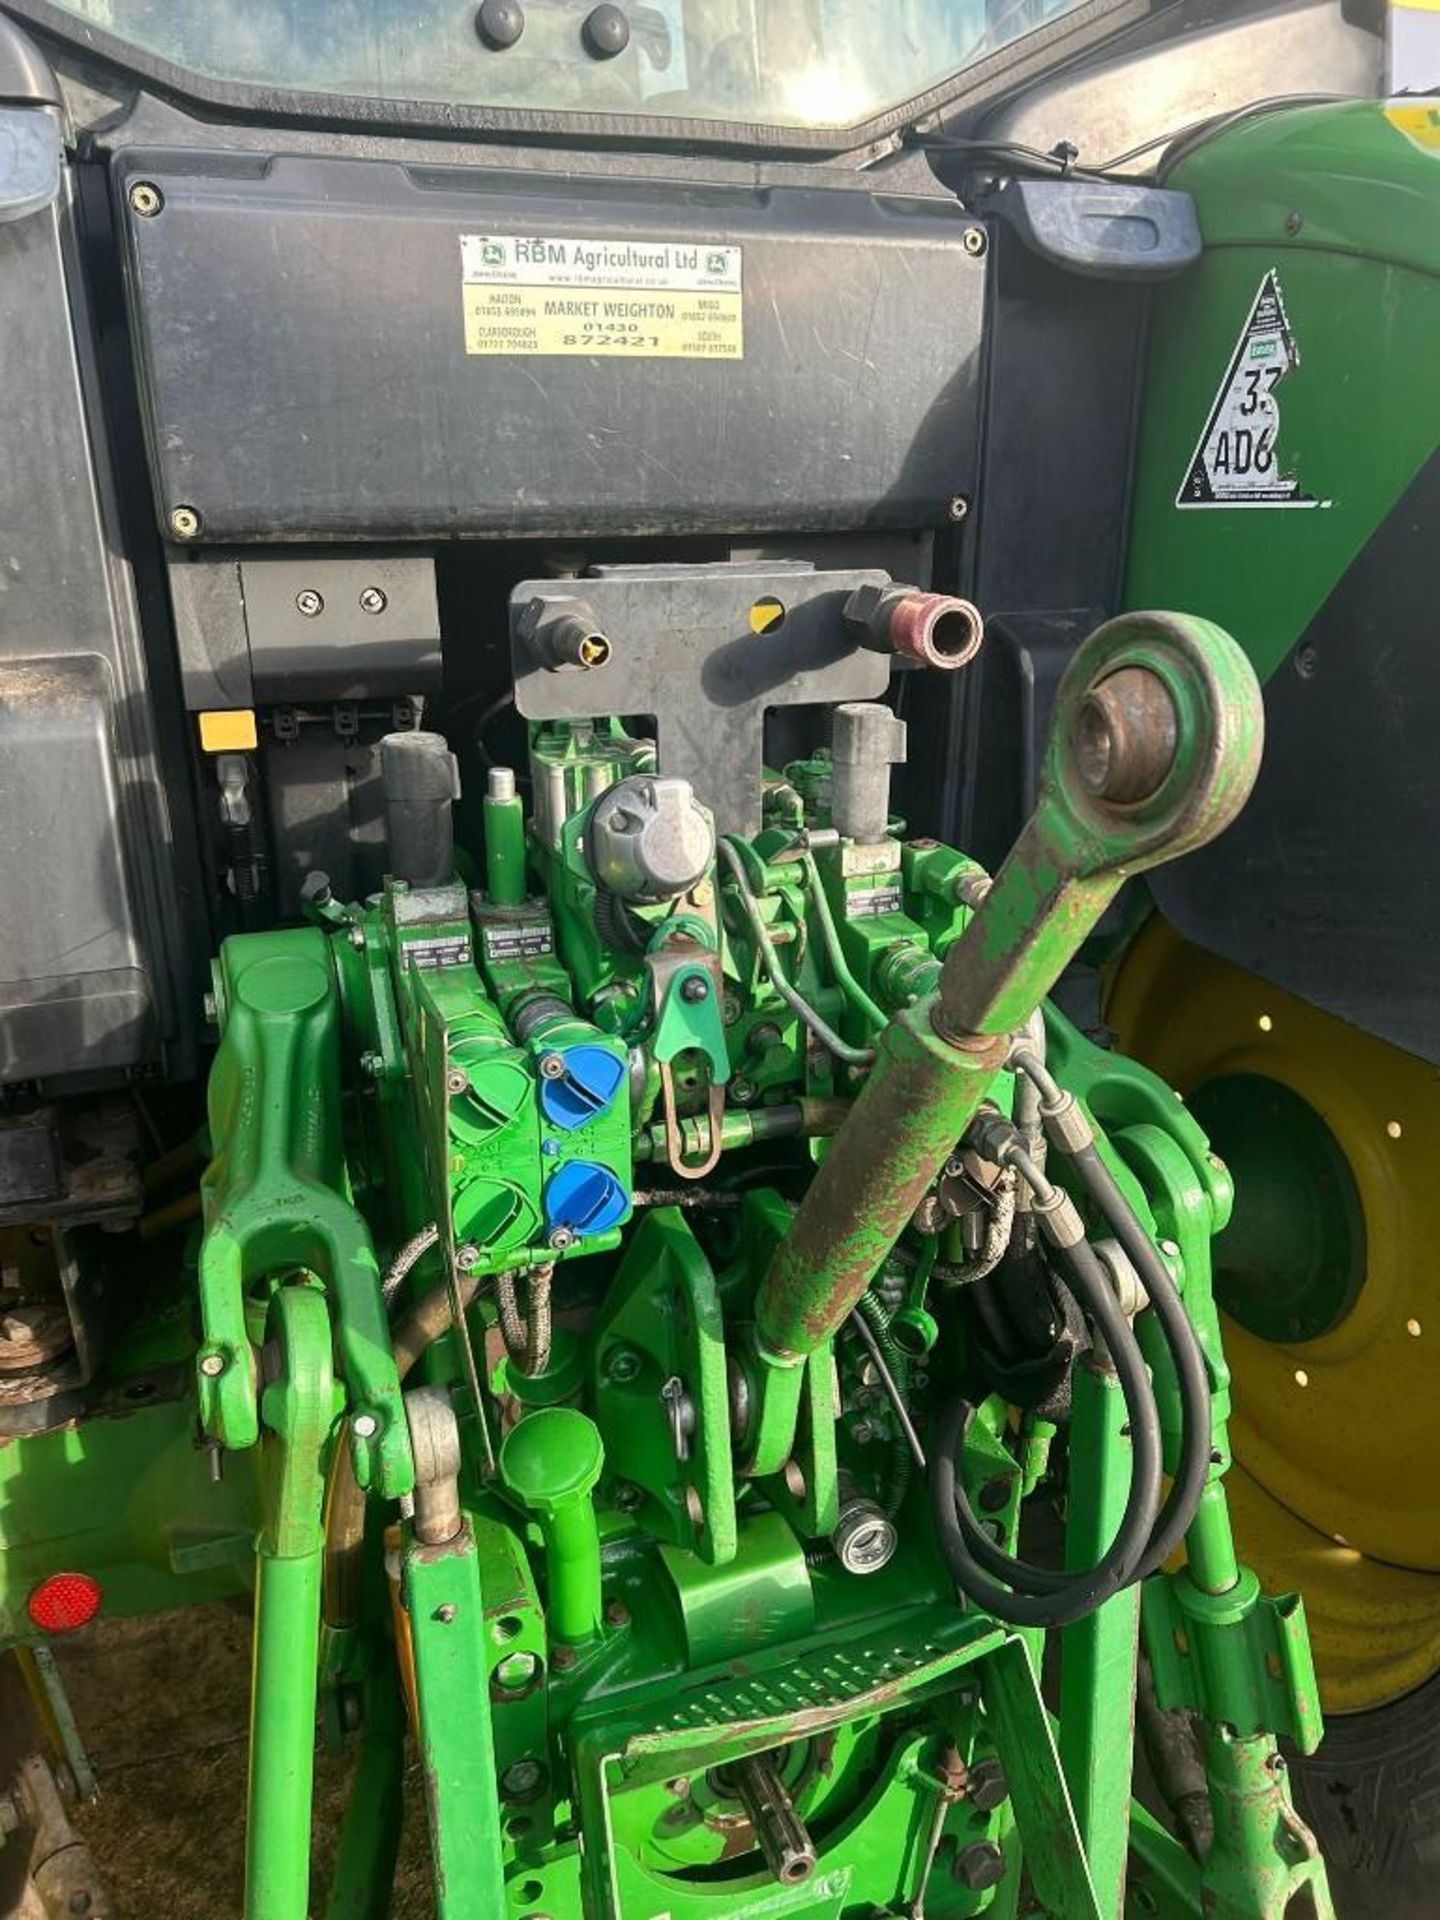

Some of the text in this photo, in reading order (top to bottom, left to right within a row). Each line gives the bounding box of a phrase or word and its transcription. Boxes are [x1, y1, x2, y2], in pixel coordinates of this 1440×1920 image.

[515, 243, 698, 272] RBM Agricultural Ltd
[544, 301, 676, 320] MARKET WEIGHTON
[583, 322, 639, 333] 01430
[562, 334, 660, 348] 872421
